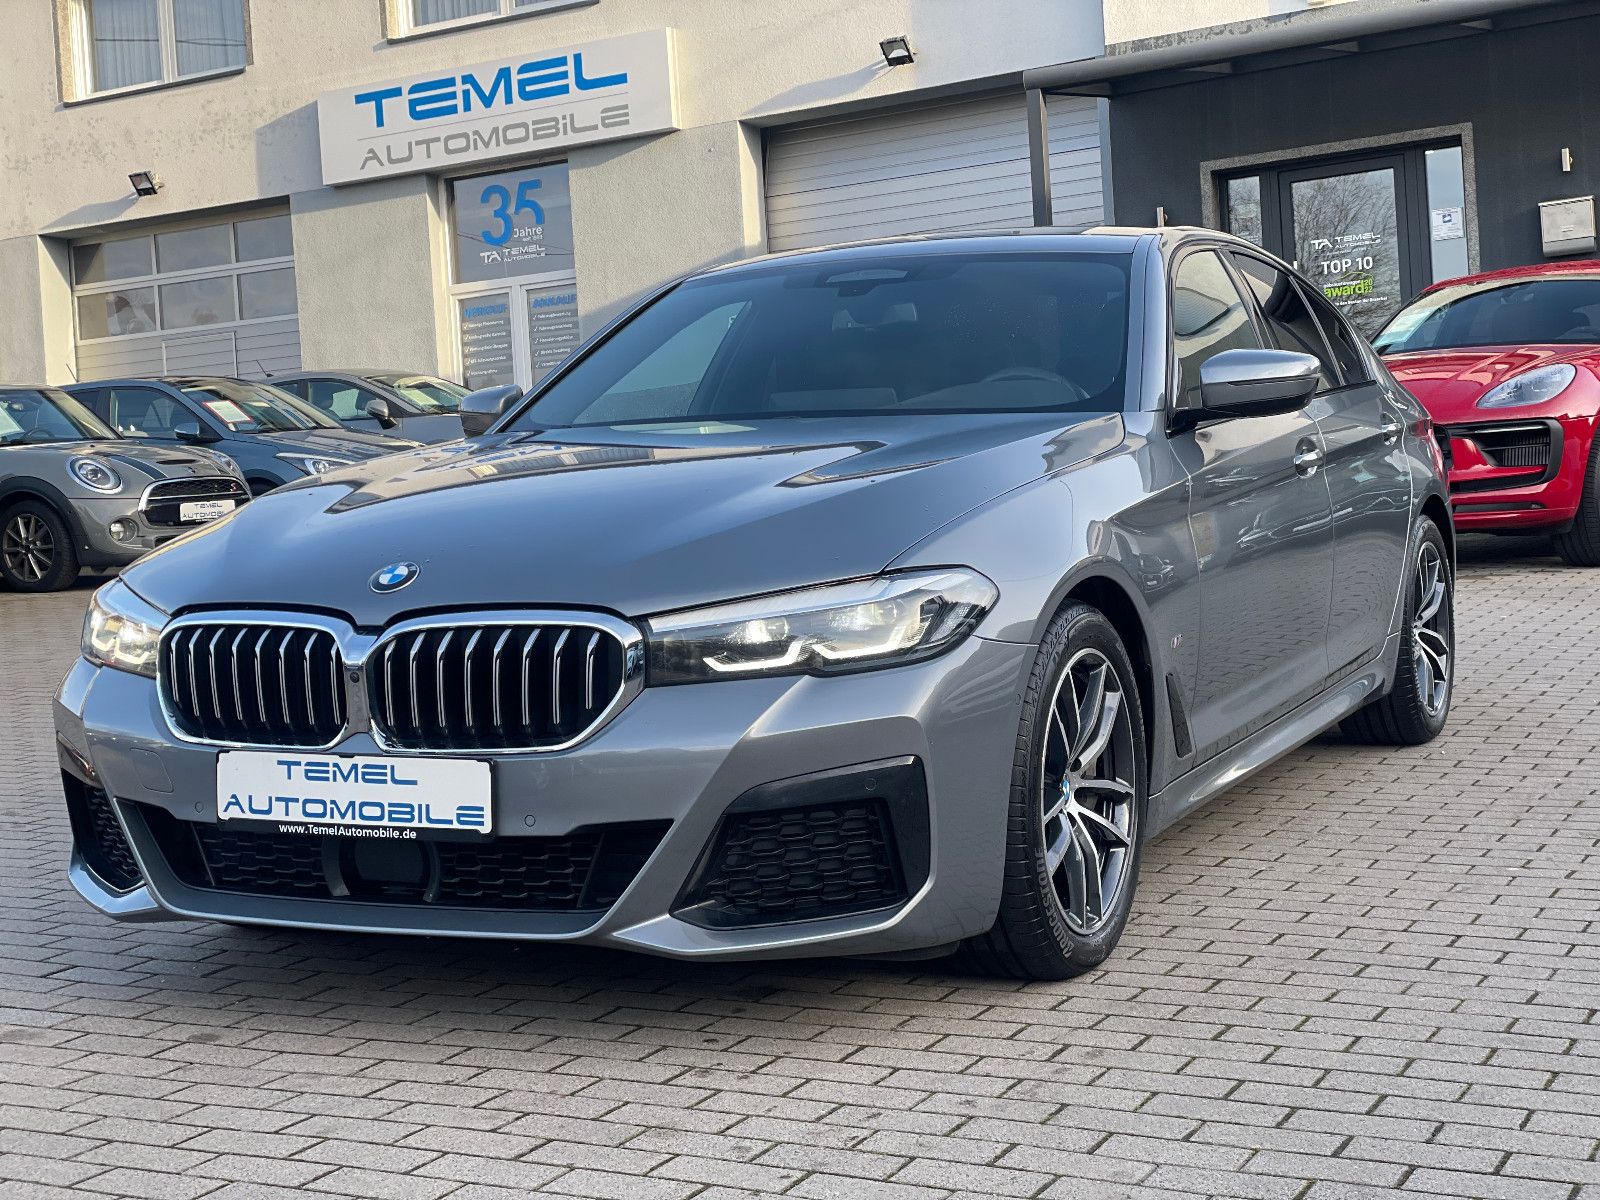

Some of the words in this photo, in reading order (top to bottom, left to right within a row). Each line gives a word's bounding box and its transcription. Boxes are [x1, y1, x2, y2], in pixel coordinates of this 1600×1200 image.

[354, 52, 628, 128] TEMEL
[480, 178, 545, 246] 35
[513, 225, 543, 238] Jahre
[1334, 232, 1381, 243] TEMEL
[502, 244, 546, 256] TEMEL
[1321, 258, 1352, 275] TOP
[1356, 256, 1374, 270] 10
[1323, 279, 1364, 298] award
[194, 502, 223, 510] TEMEL
[276, 759, 418, 786] TEMEL
[222, 793, 485, 827] AUTOMOBILE
[278, 824, 417, 840] www.TemelAutomobile.de
